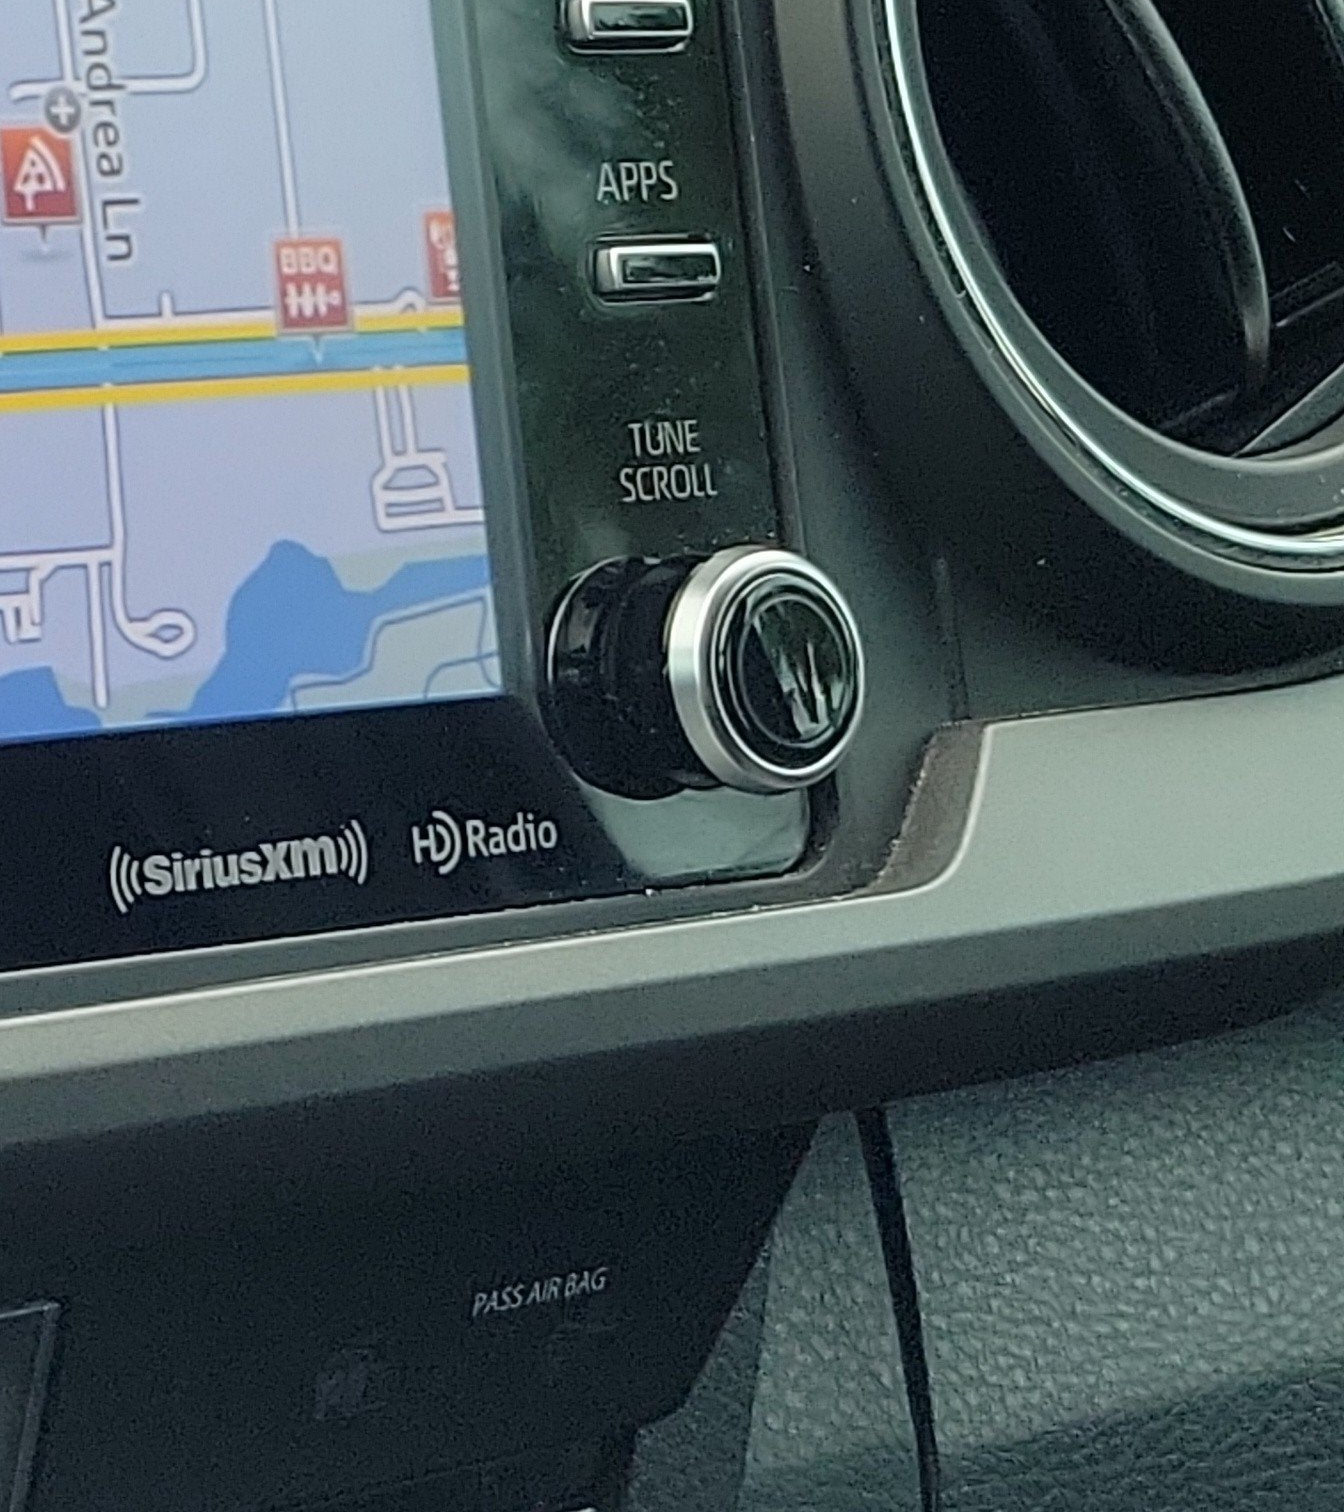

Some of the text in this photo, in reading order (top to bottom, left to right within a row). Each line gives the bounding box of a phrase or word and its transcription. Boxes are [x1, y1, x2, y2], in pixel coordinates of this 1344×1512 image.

[597, 161, 679, 201] APPS
[102, 195, 142, 264] Ln
[279, 245, 340, 276] BBQ
[628, 419, 702, 457] TUNE
[619, 464, 718, 504] SCROLL
[412, 810, 558, 875] HD Radio
[472, 1266, 610, 1317] PASS AIR BAG
